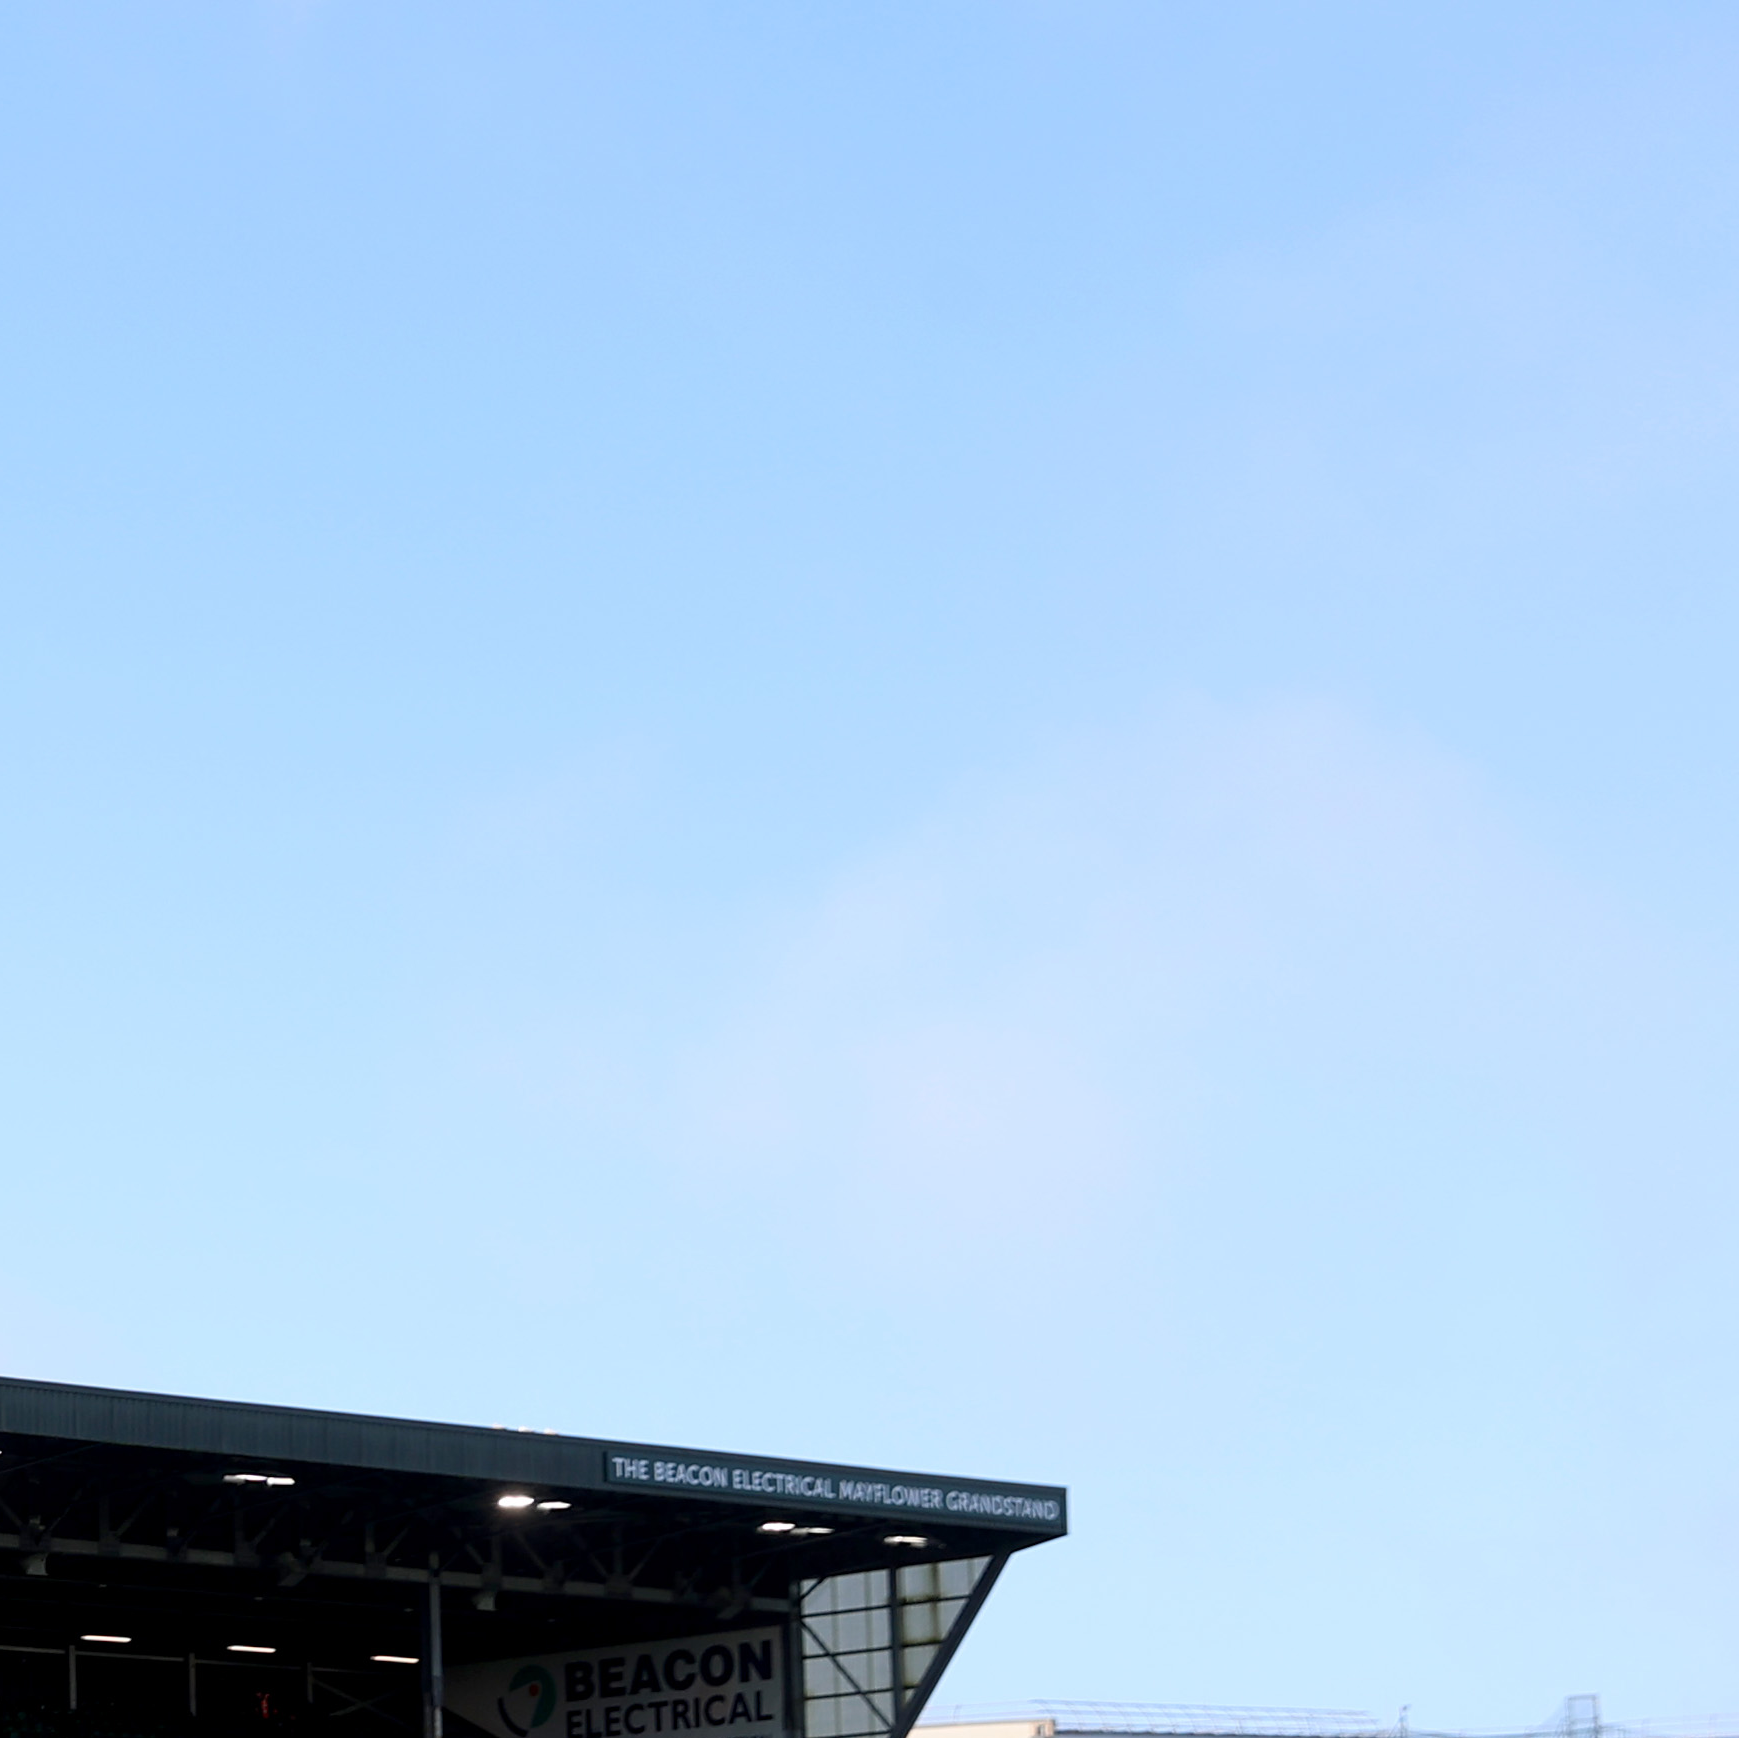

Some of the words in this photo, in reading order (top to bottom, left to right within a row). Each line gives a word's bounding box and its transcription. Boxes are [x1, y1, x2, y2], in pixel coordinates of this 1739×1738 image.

[612, 1457, 650, 1480] THE
[654, 1461, 728, 1488] BEACON
[732, 1469, 836, 1500] ELECTRICAL
[839, 1480, 943, 1509] MAYFLOWER
[946, 1491, 1060, 1520] GRANDSTAND
[565, 1640, 772, 1702] BEACON
